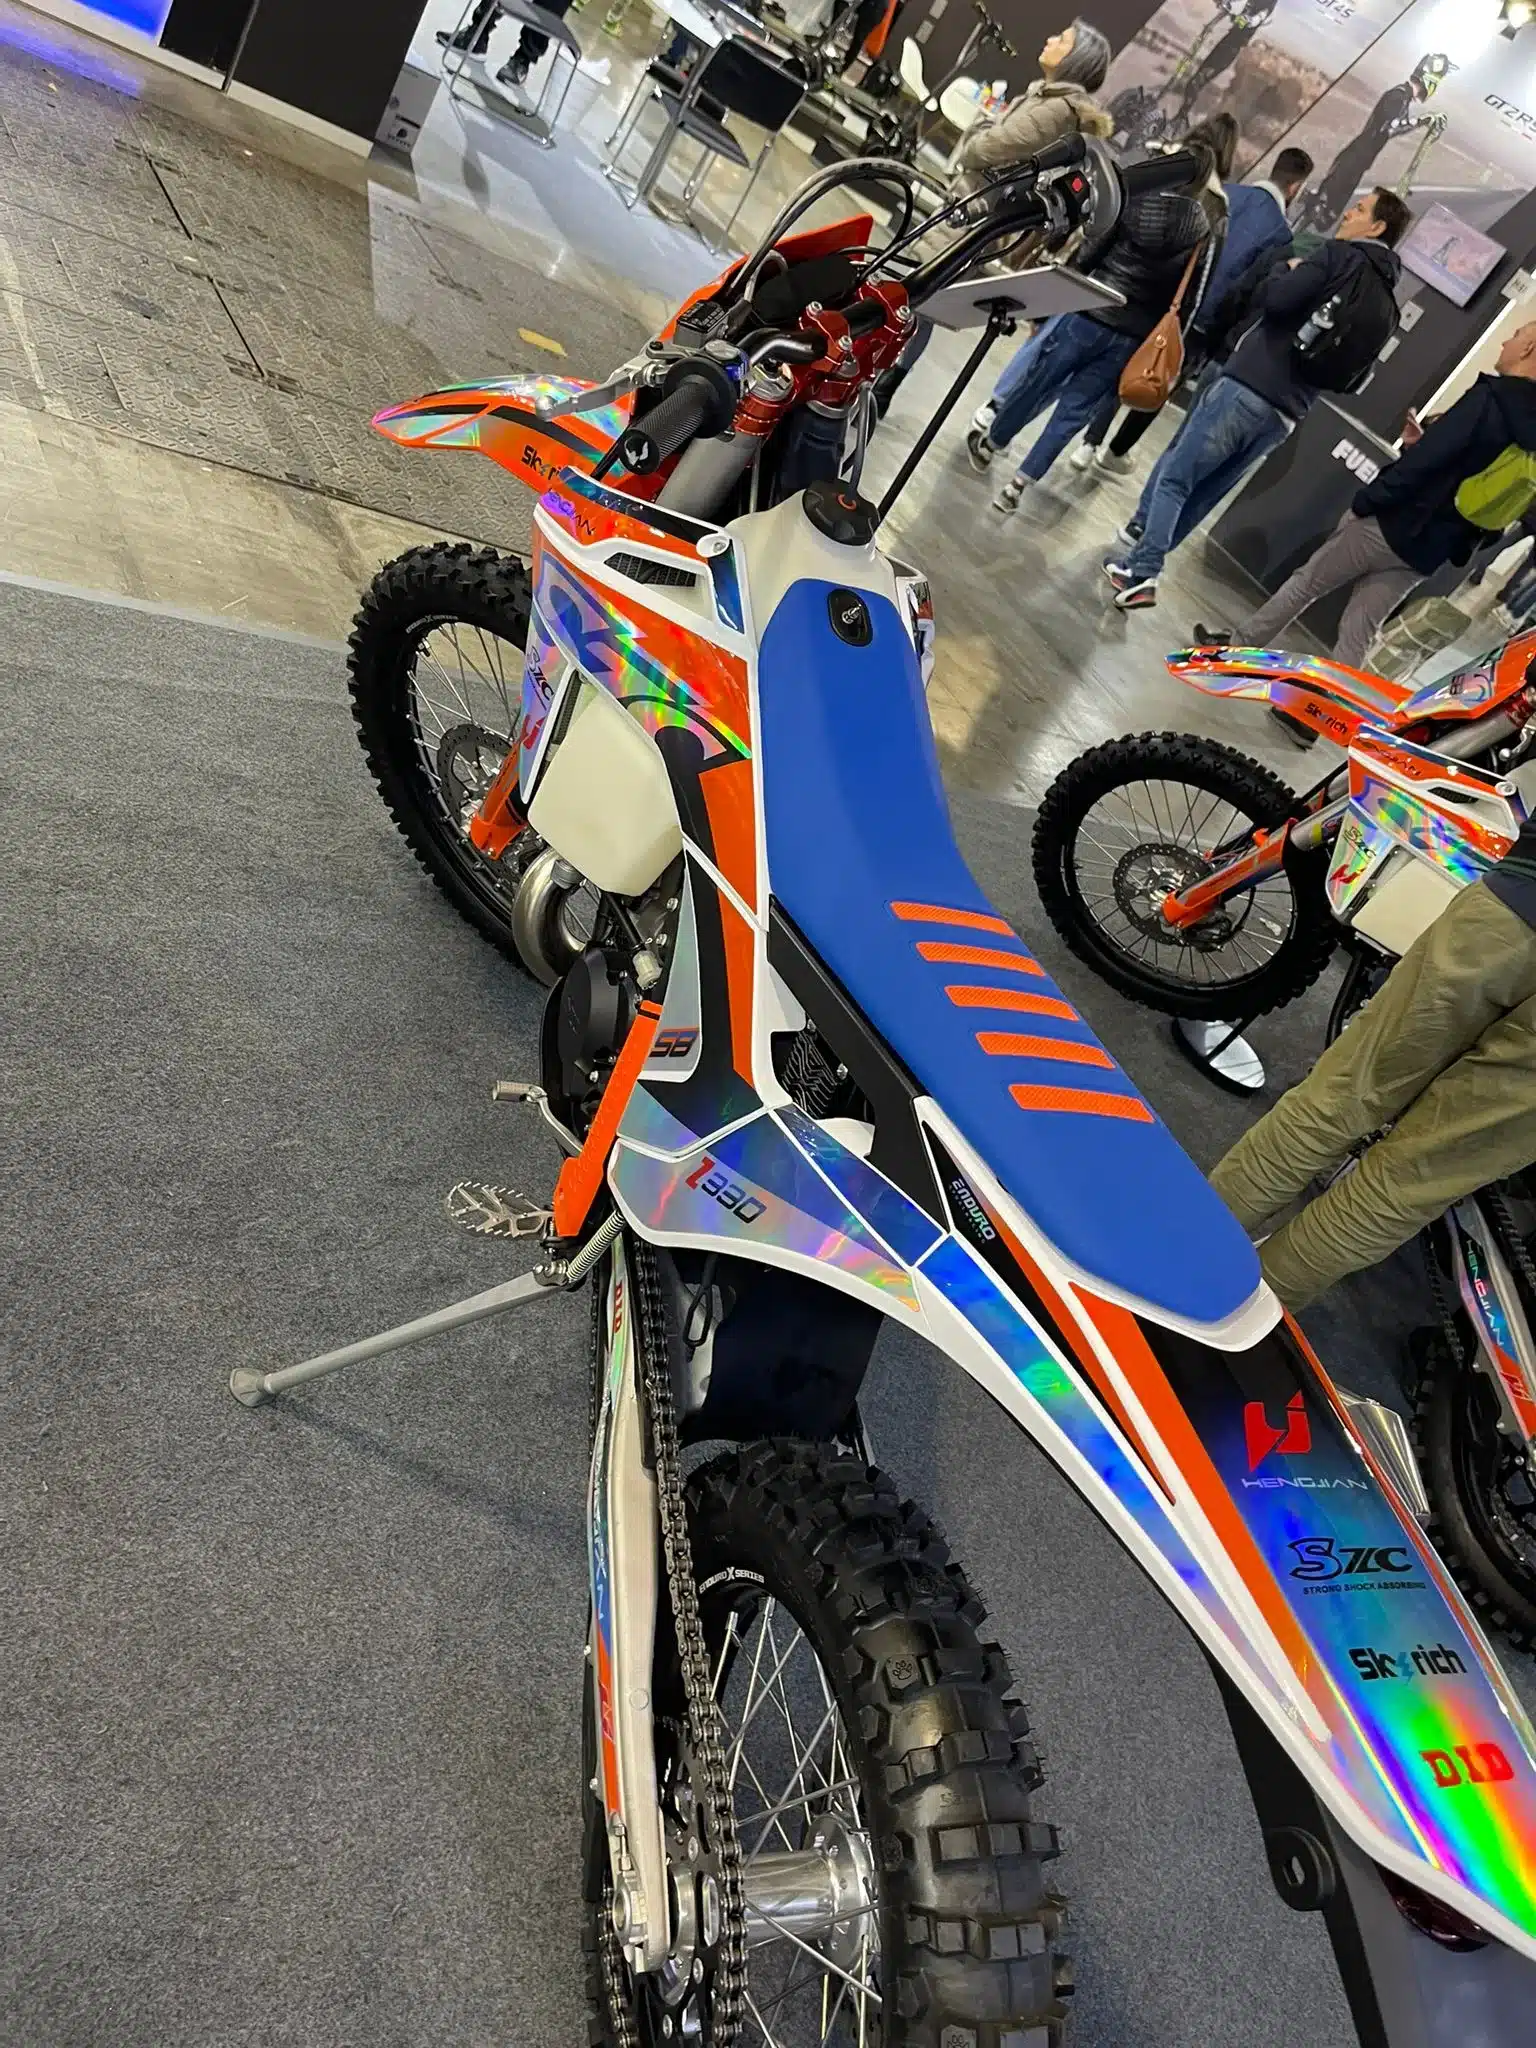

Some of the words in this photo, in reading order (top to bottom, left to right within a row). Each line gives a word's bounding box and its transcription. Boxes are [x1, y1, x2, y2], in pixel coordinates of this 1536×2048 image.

[952, 1178, 996, 1241] ENDURO
[1241, 1477, 1369, 1491] HENGJIAN
[734, 1569, 765, 1584] SERIES
[1303, 1584, 1341, 1595] STRONG
[1344, 1582, 1376, 1593] SHOCK
